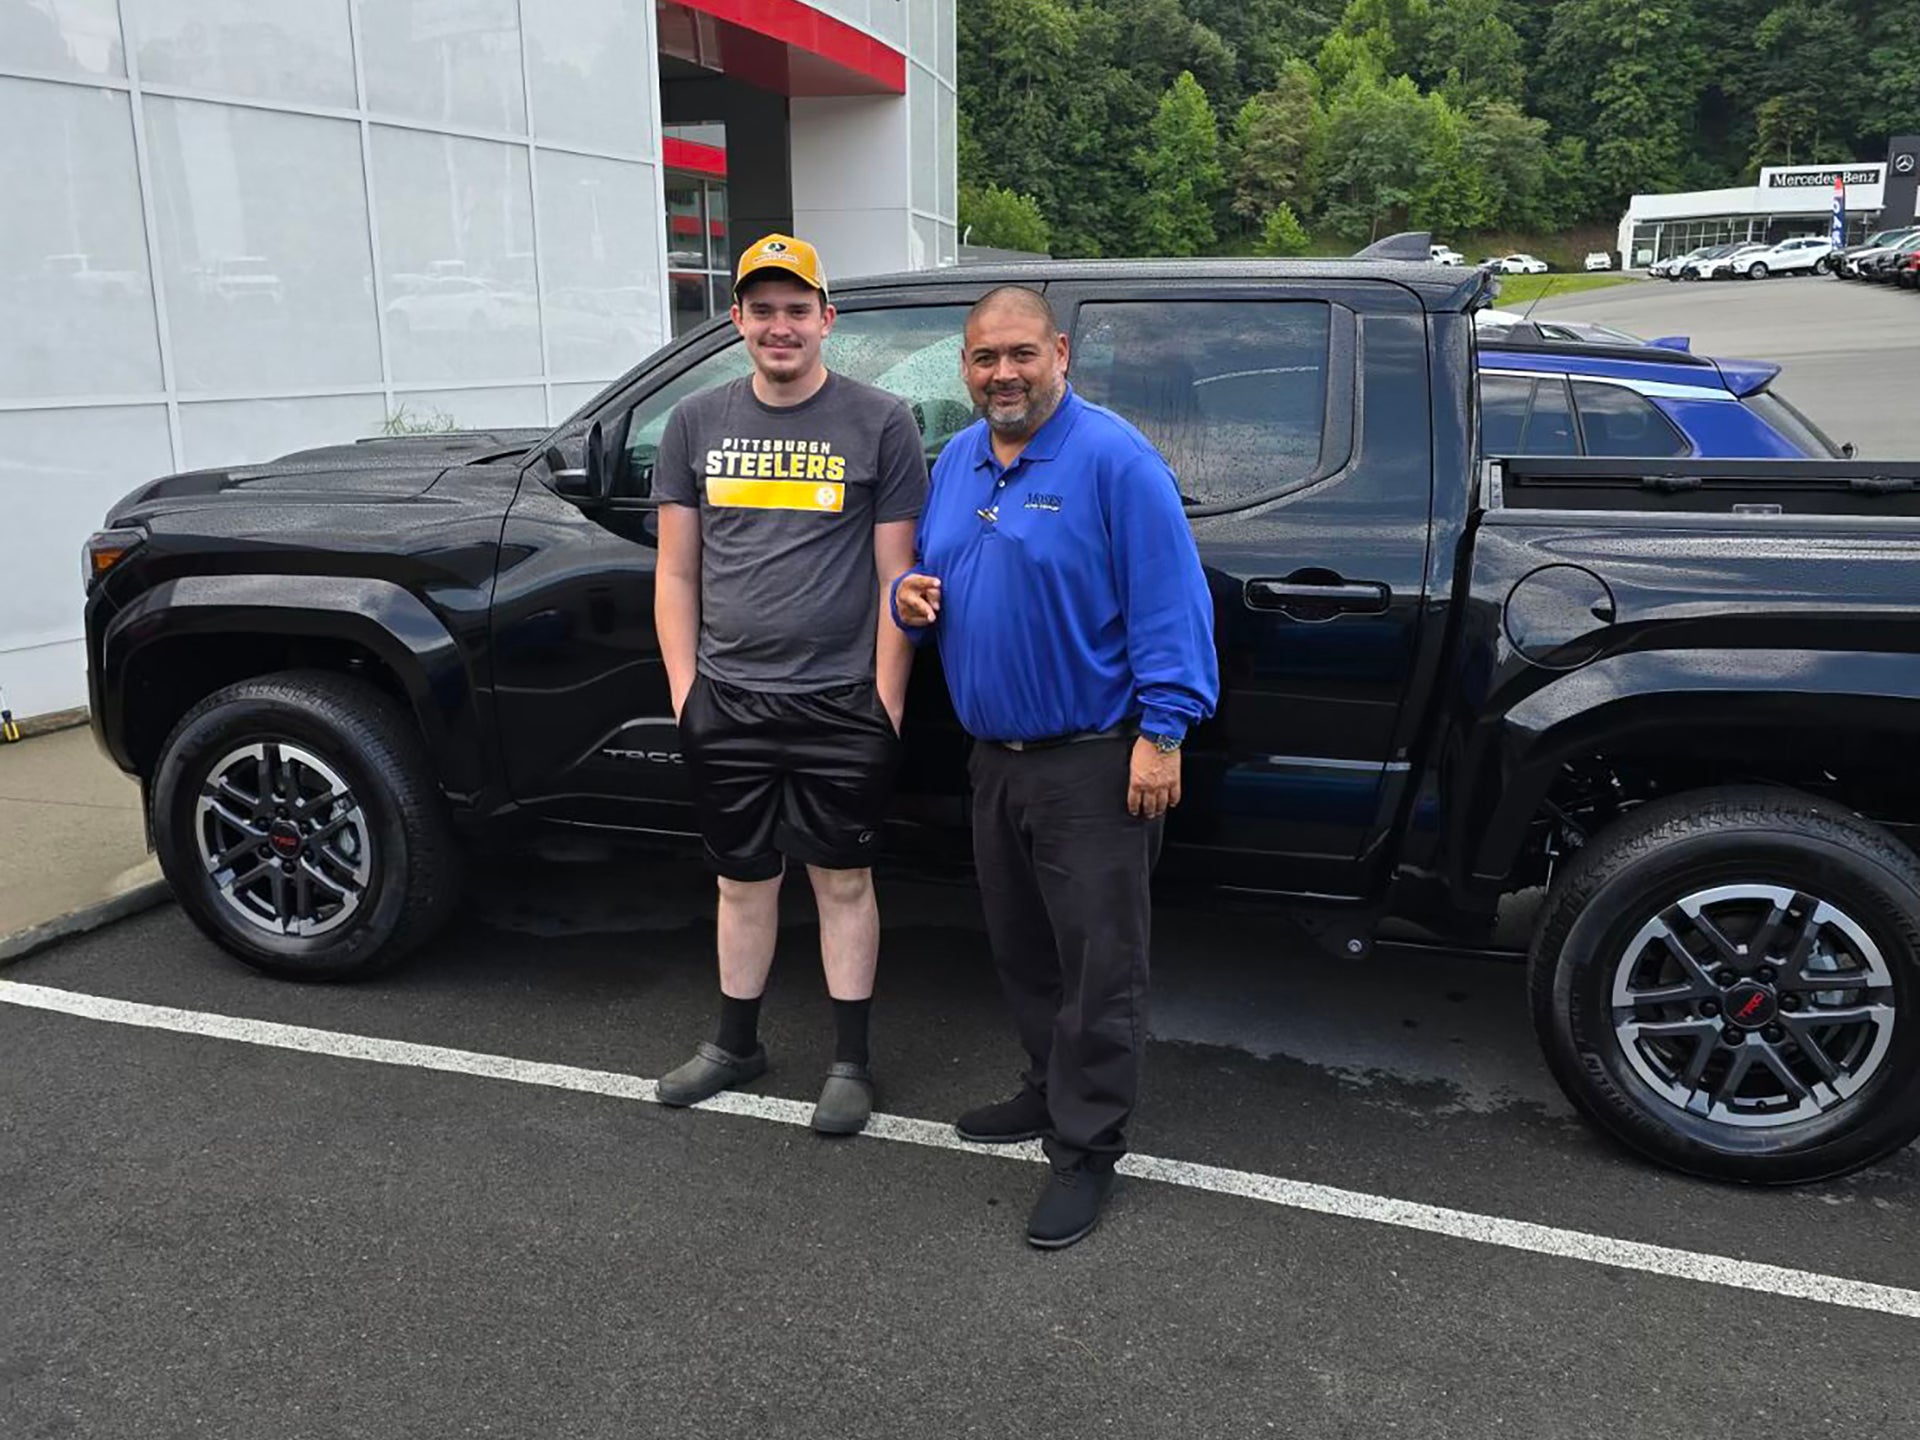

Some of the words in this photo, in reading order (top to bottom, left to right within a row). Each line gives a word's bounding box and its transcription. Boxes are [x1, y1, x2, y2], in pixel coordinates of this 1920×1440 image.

[722, 438, 831, 455] PITTSBURGH
[705, 450, 846, 481] STEELERS
[1734, 990, 1767, 1018] TRD
